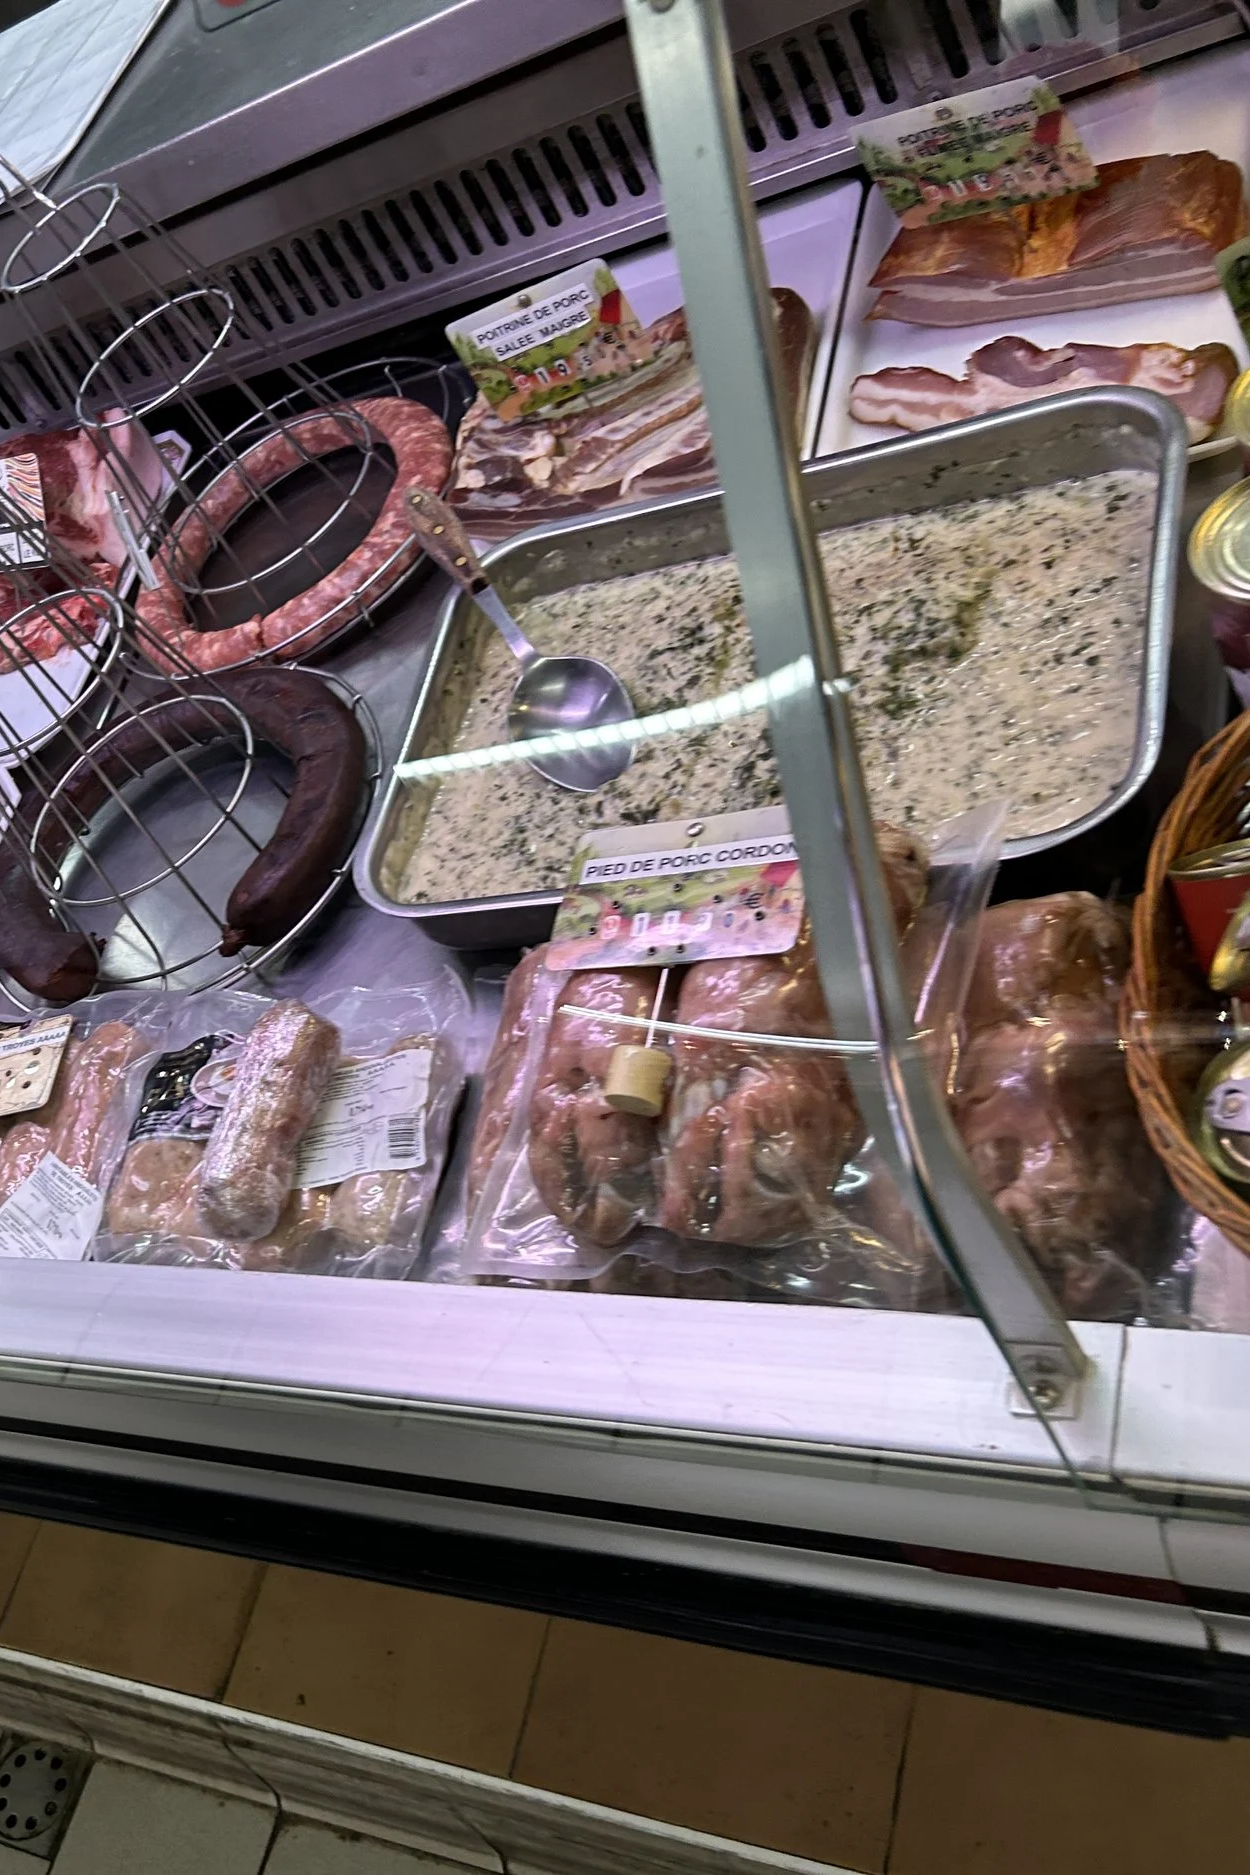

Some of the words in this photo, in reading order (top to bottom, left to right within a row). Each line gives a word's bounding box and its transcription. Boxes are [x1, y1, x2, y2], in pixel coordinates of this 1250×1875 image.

[477, 314, 533, 345] POITRINE
[535, 307, 551, 320] DE
[554, 290, 590, 312] PORC
[495, 334, 535, 357] SALEE
[539, 310, 589, 337] MAIGRE
[585, 862, 626, 878] PIED
[630, 858, 654, 872] DE
[658, 852, 712, 869] PORC
[2, 1038, 36, 1052] TROYES
[37, 1031, 66, 1043] AAAAA
